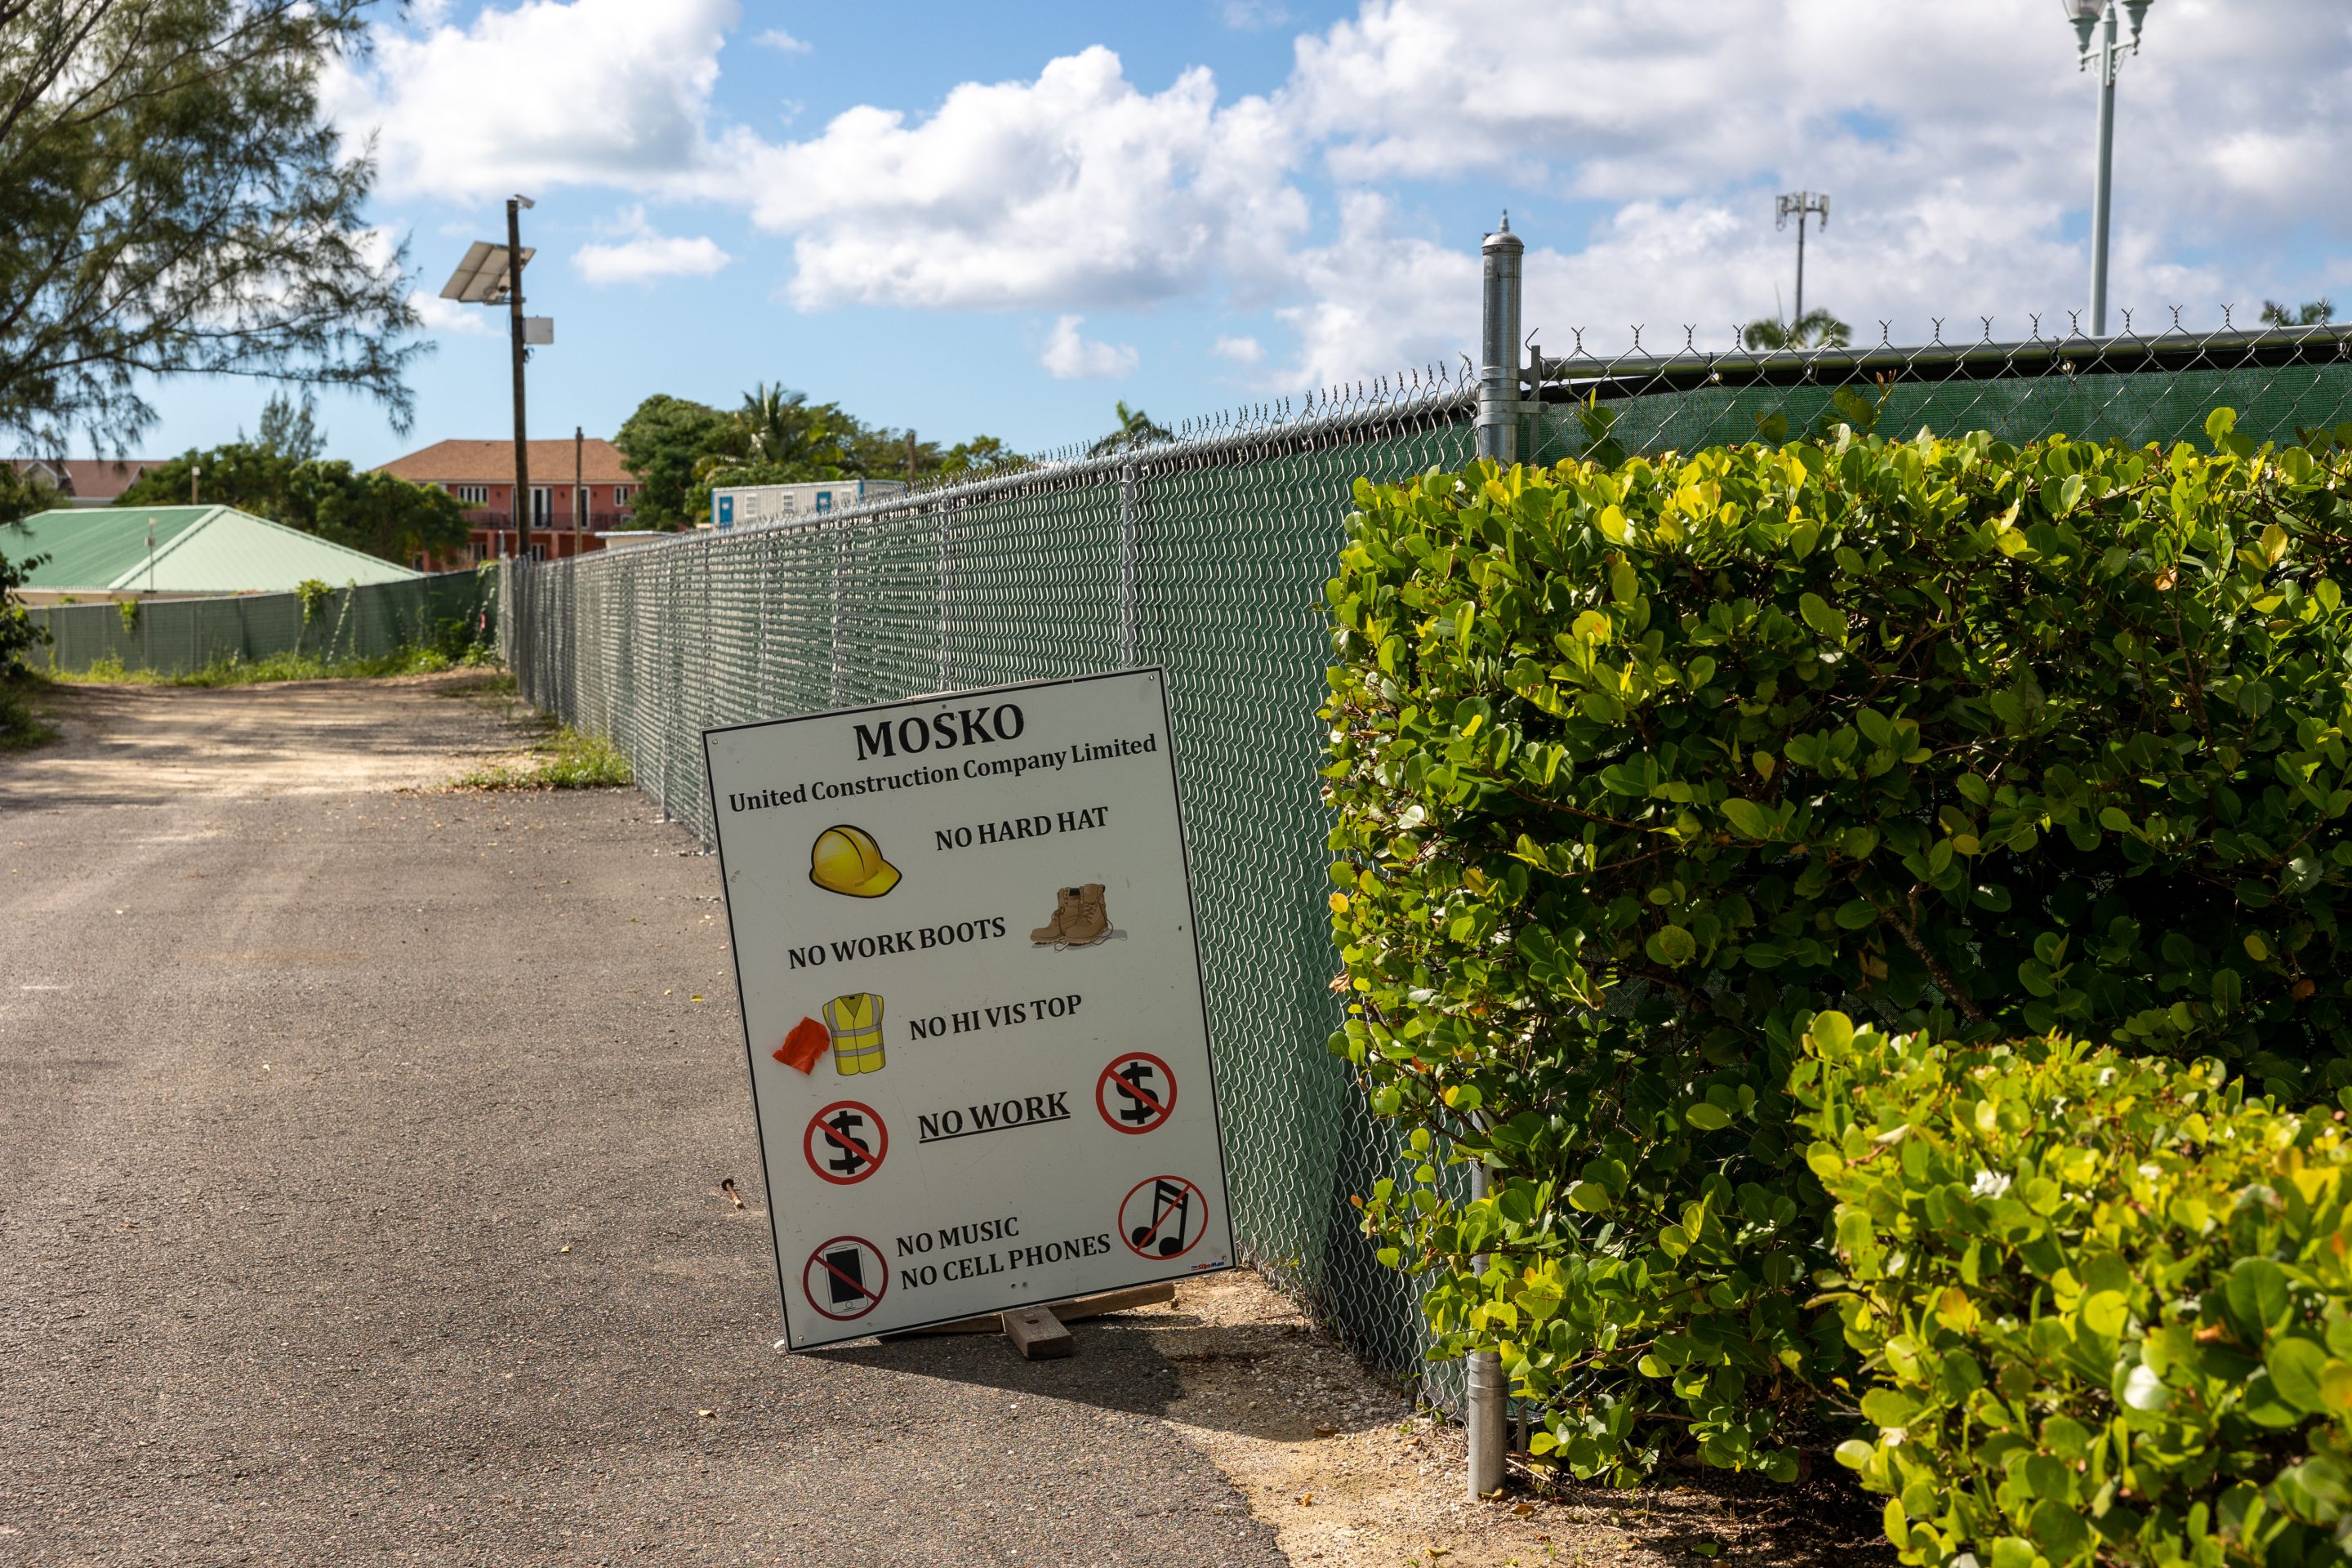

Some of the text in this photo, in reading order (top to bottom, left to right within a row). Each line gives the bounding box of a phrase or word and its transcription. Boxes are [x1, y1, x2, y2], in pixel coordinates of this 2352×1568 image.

[853, 703, 1024, 761] MOSKO
[728, 733, 1157, 813] United Construction Company Limited
[934, 806, 1108, 851] NO HARD HAT
[787, 916, 1006, 969] NO WORK BOOTS
[908, 994, 1082, 1040] NO HI VIS TOP
[917, 1091, 1071, 1139] NO WORK
[896, 1216, 1019, 1258] NO MUSIC
[900, 1233, 1111, 1290] NO CELL PHONES
